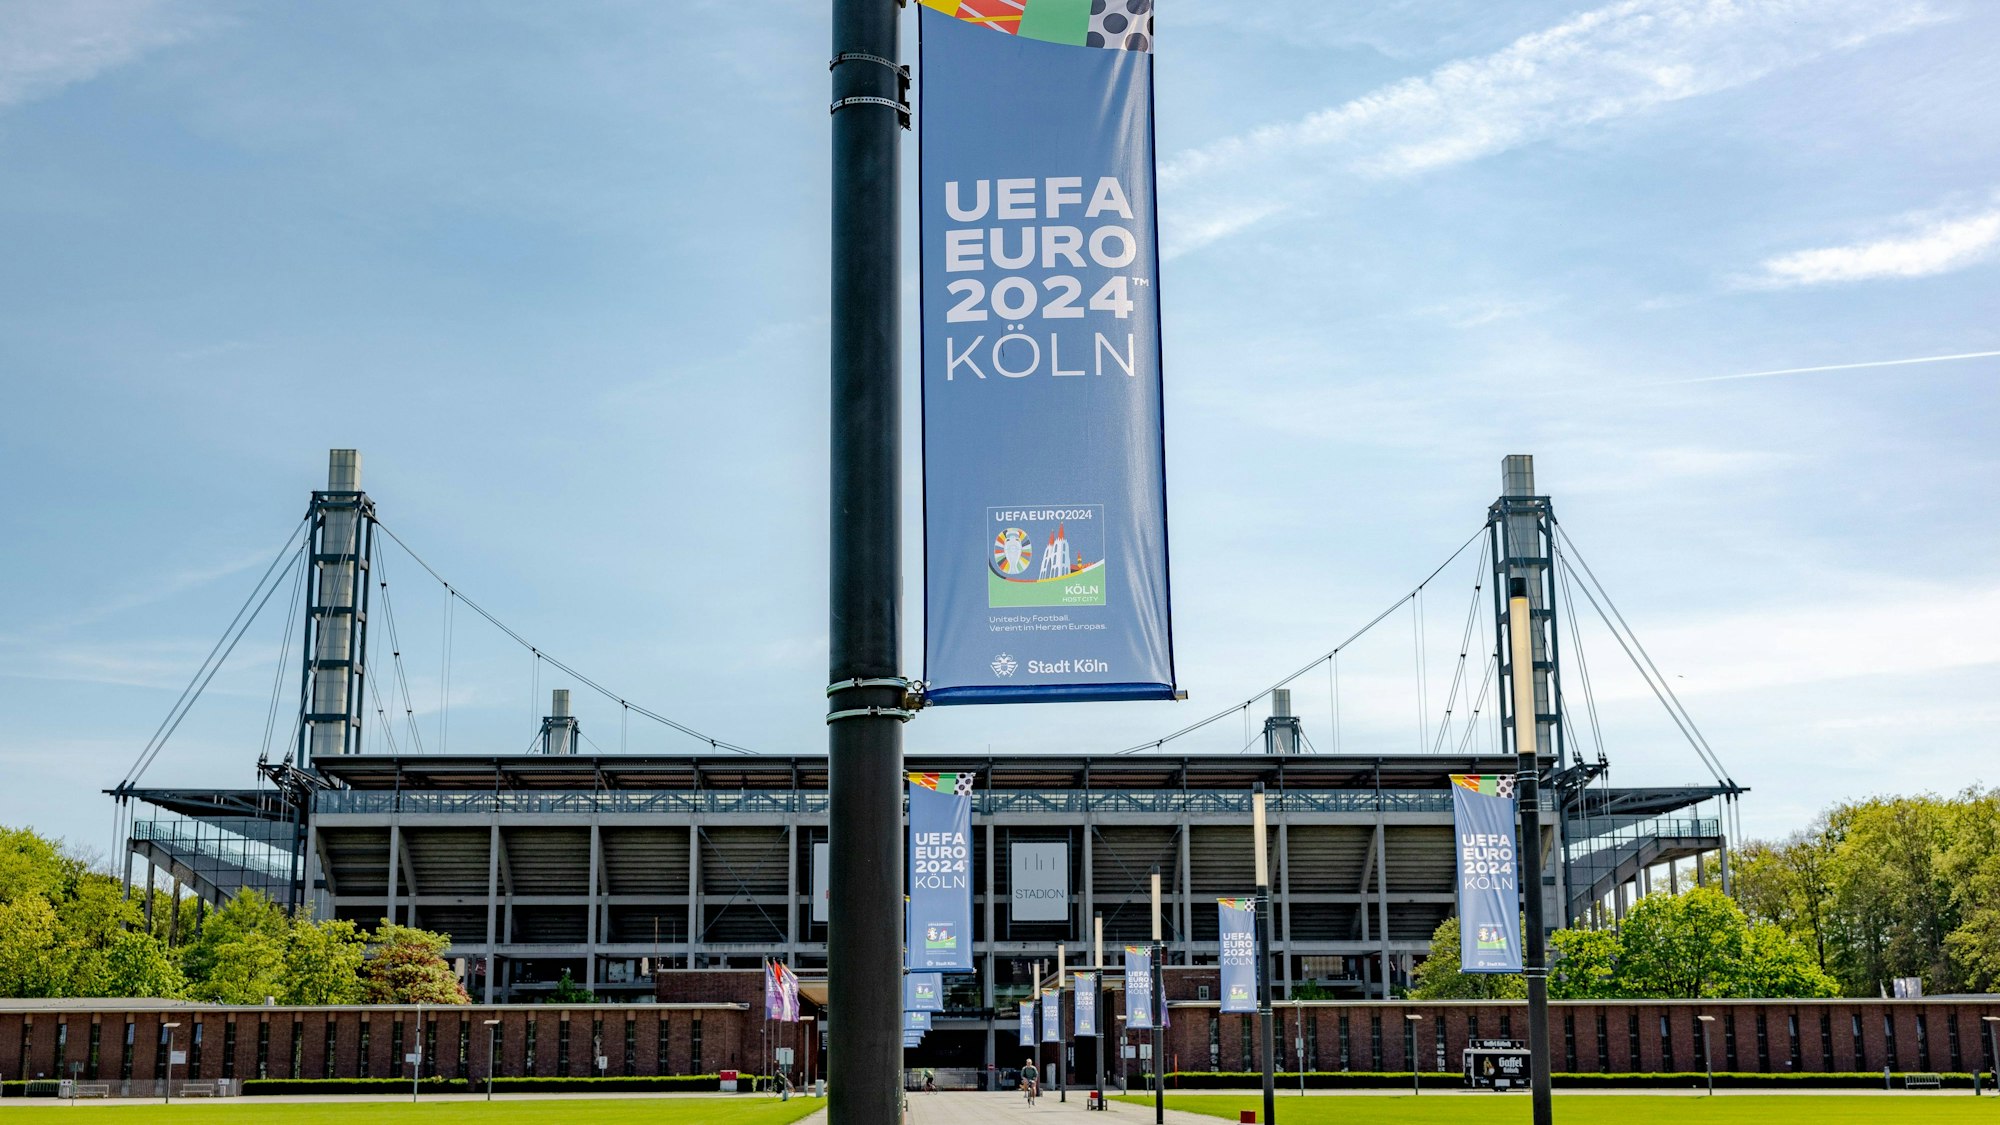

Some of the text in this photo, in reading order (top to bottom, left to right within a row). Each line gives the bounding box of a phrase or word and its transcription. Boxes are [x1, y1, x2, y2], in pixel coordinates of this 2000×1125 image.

[945, 176, 1134, 222] UEFA
[945, 225, 1137, 272] EURO
[946, 275, 1134, 323] 2024
[946, 323, 1135, 381] KÖLN
[1065, 583, 1099, 595] KÖLN
[989, 614, 1070, 624] United by Football.
[989, 624, 1023, 632] Vereint
[1068, 623, 1107, 631] Europas.
[1027, 659, 1108, 674] Stadt Köln
[915, 832, 966, 845] UEFA
[1462, 834, 1512, 847] UEFA
[915, 846, 967, 859] EURO
[1463, 847, 1513, 860] EURO
[915, 860, 965, 873] 2024
[1464, 861, 1512, 874] 2024
[915, 873, 965, 889] KÖLN
[1464, 874, 1513, 890] KÖLN
[1015, 888, 1064, 899] STADION
[1223, 932, 1252, 940] UEFA
[1223, 940, 1253, 948] EURO
[1223, 948, 1252, 957] 2024
[1498, 1057, 1522, 1067] Gaffel
